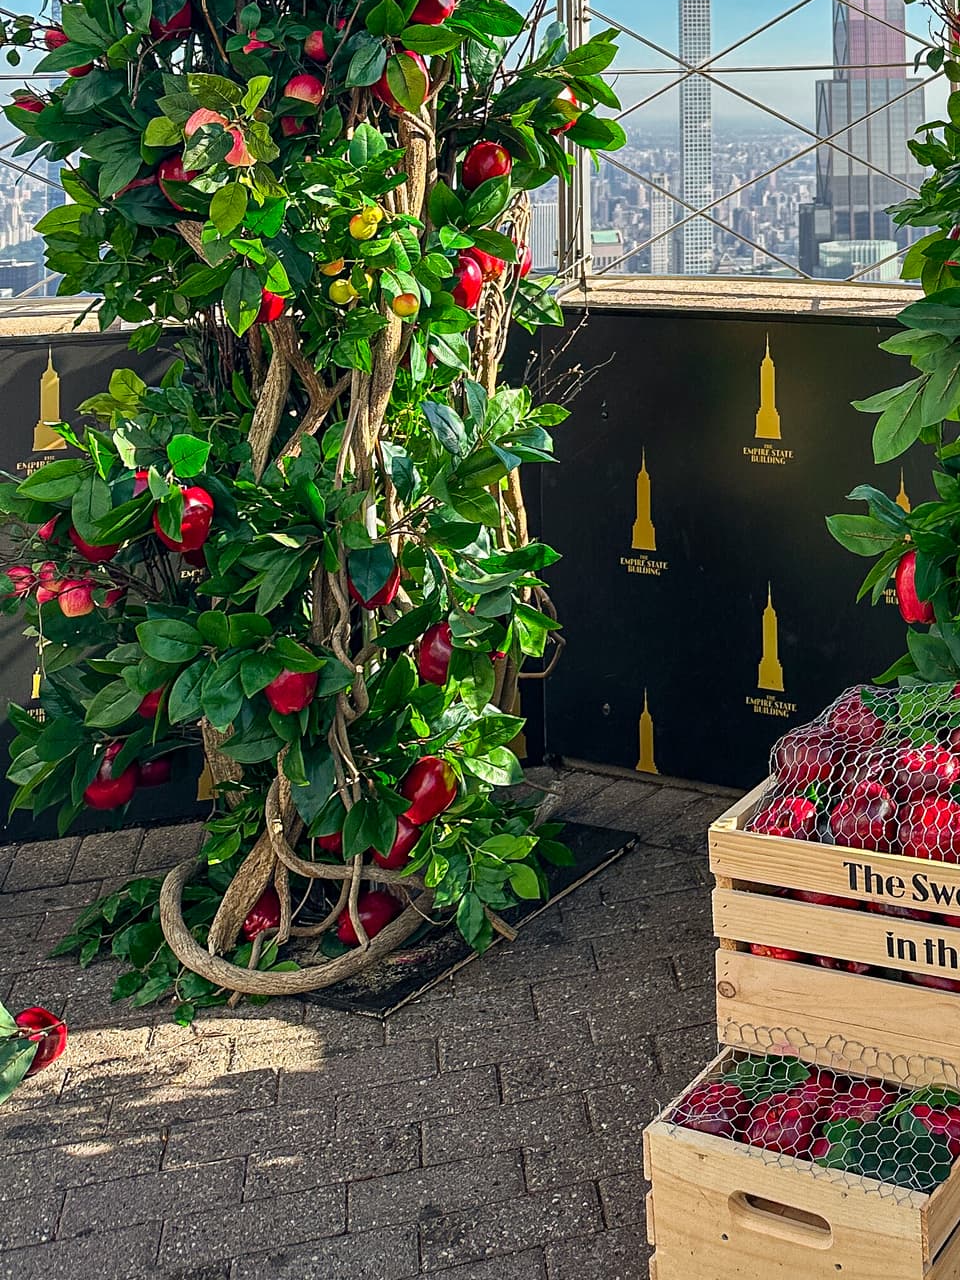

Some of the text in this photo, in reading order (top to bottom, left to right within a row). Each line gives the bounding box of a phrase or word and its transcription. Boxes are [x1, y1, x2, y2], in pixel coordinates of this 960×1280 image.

[743, 447, 794, 459] EMPIRE STATE
[751, 455, 786, 465] BUILDING
[627, 565, 661, 576] BUILDING
[646, 560, 669, 570] STATE
[753, 705, 790, 718] BUILDING
[773, 701, 798, 713] STATE
[843, 862, 906, 898] The
[886, 931, 917, 962] in
